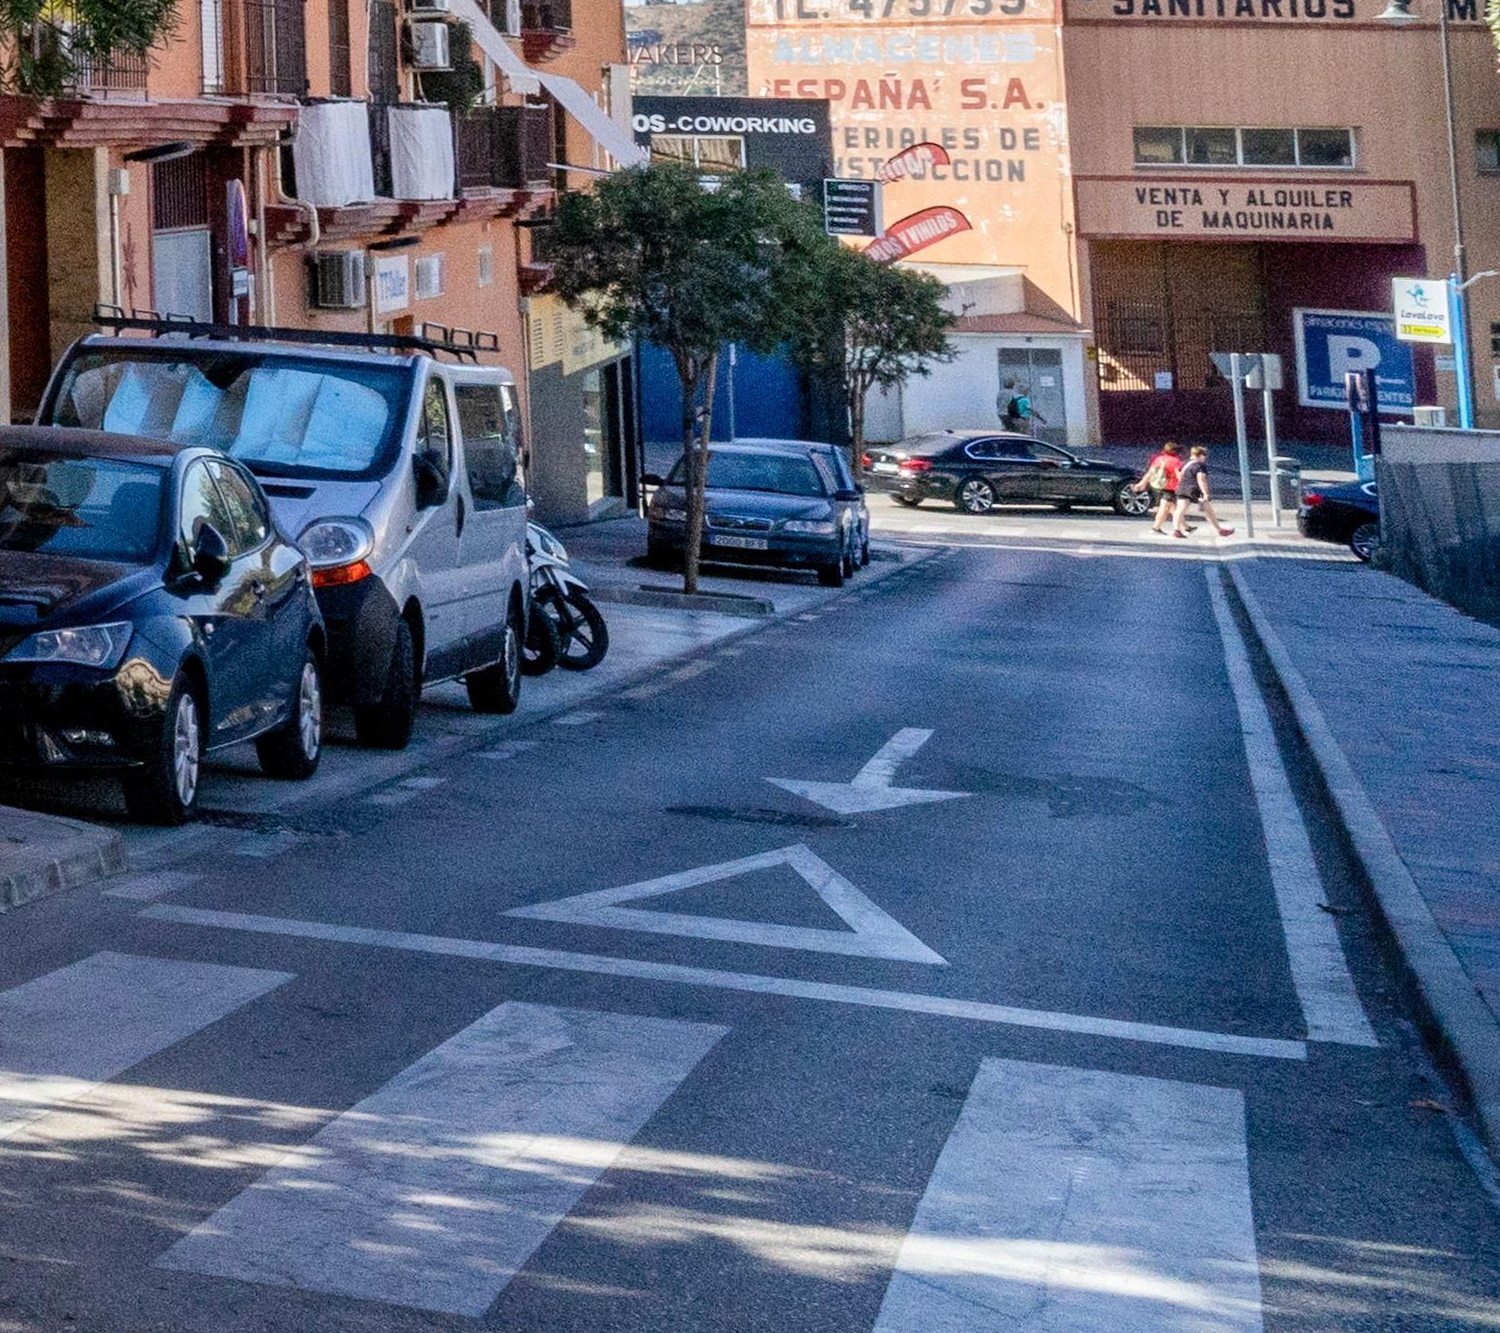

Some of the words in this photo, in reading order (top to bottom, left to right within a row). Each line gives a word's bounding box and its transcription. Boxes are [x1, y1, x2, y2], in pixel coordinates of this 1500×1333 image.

[961, 78, 1046, 110] S.A.
[1000, 127, 1041, 151] DE
[1135, 188, 1202, 206] VENTA
[1220, 189, 1229, 206] Y
[1246, 189, 1353, 208] ALQUILER
[909, 211, 959, 246] VINILOS
[1157, 211, 1183, 228] DE
[1202, 212, 1334, 231] MAQUINARIA
[1327, 334, 1381, 383] P
